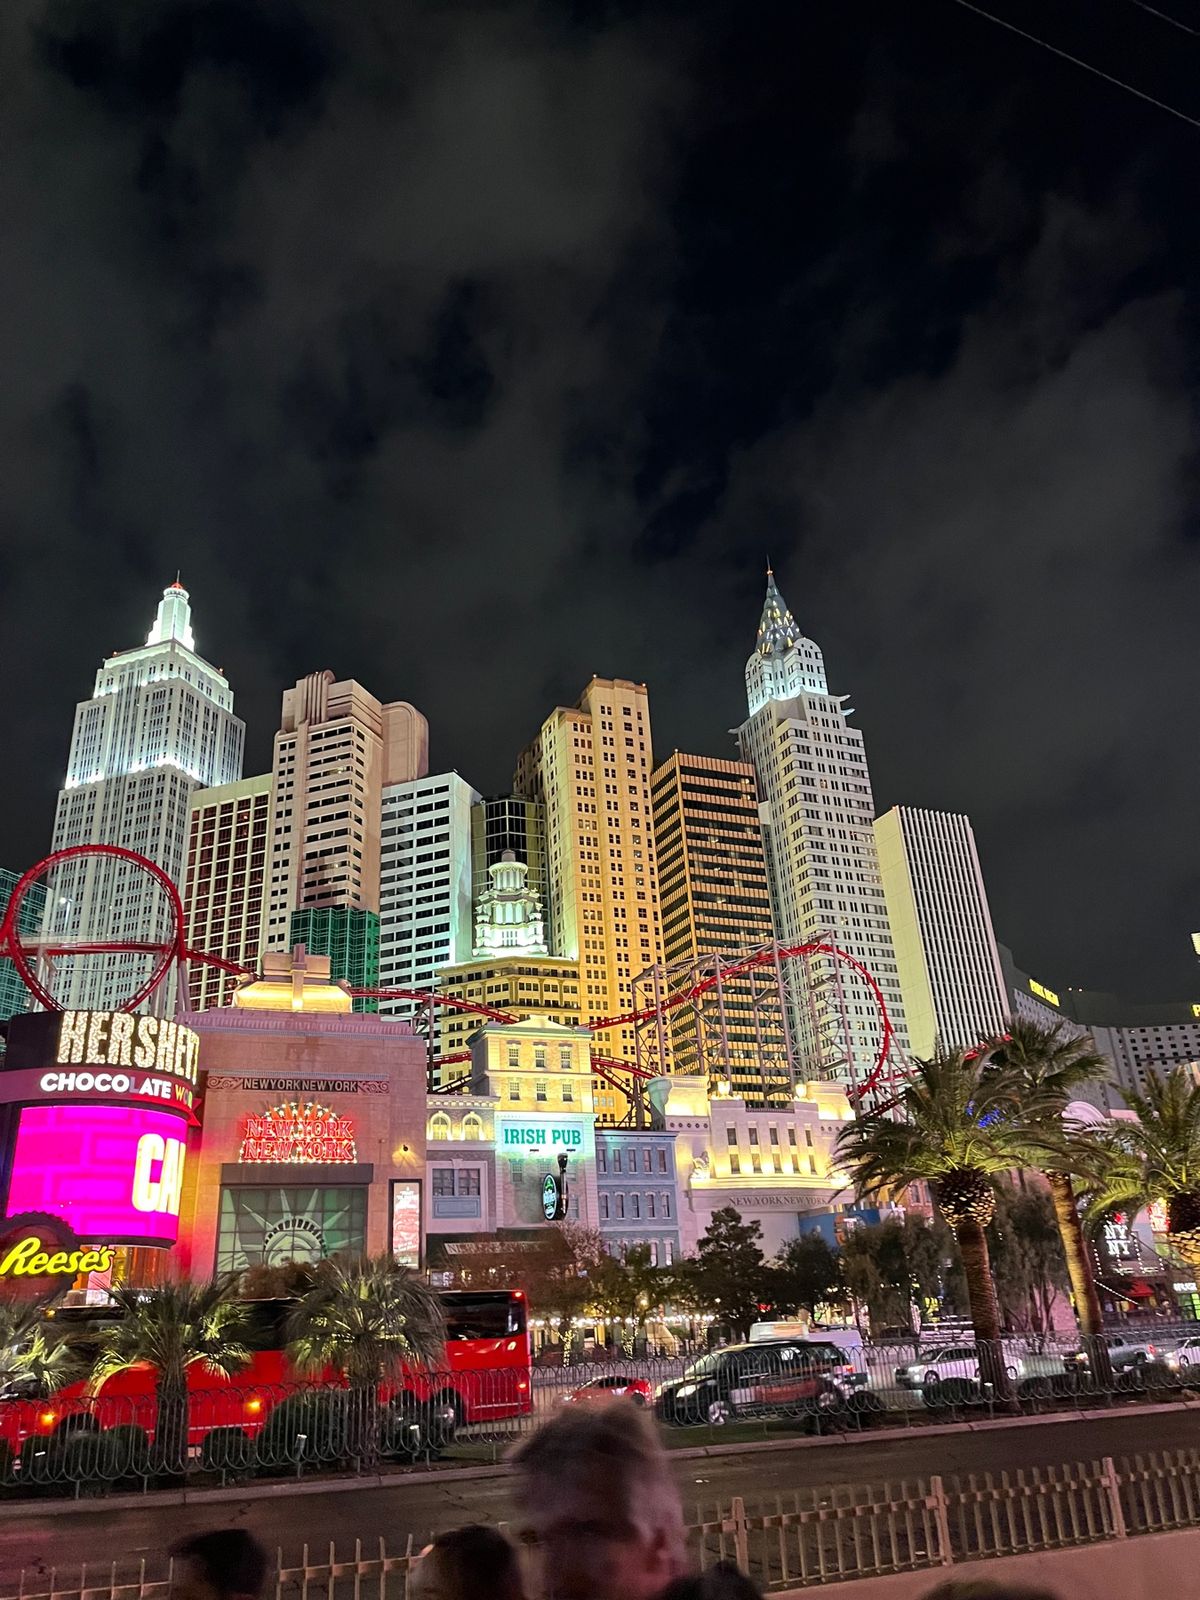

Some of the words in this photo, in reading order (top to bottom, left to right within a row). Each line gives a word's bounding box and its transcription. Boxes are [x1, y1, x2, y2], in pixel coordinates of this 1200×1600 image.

[40, 1072, 172, 1099] CHOCOLATE
[246, 1118, 295, 1139] NEW
[300, 1119, 354, 1139] YORK
[504, 1128, 546, 1145] IRISH
[552, 1129, 581, 1145] PUB
[244, 1139, 293, 1160] NEW
[296, 1139, 352, 1160] YORK
[729, 1196, 752, 1206] NEW
[754, 1195, 783, 1206] YORK
[1103, 1223, 1128, 1239] NY
[0, 1236, 116, 1276] Reese's
[1106, 1240, 1131, 1255] NY
